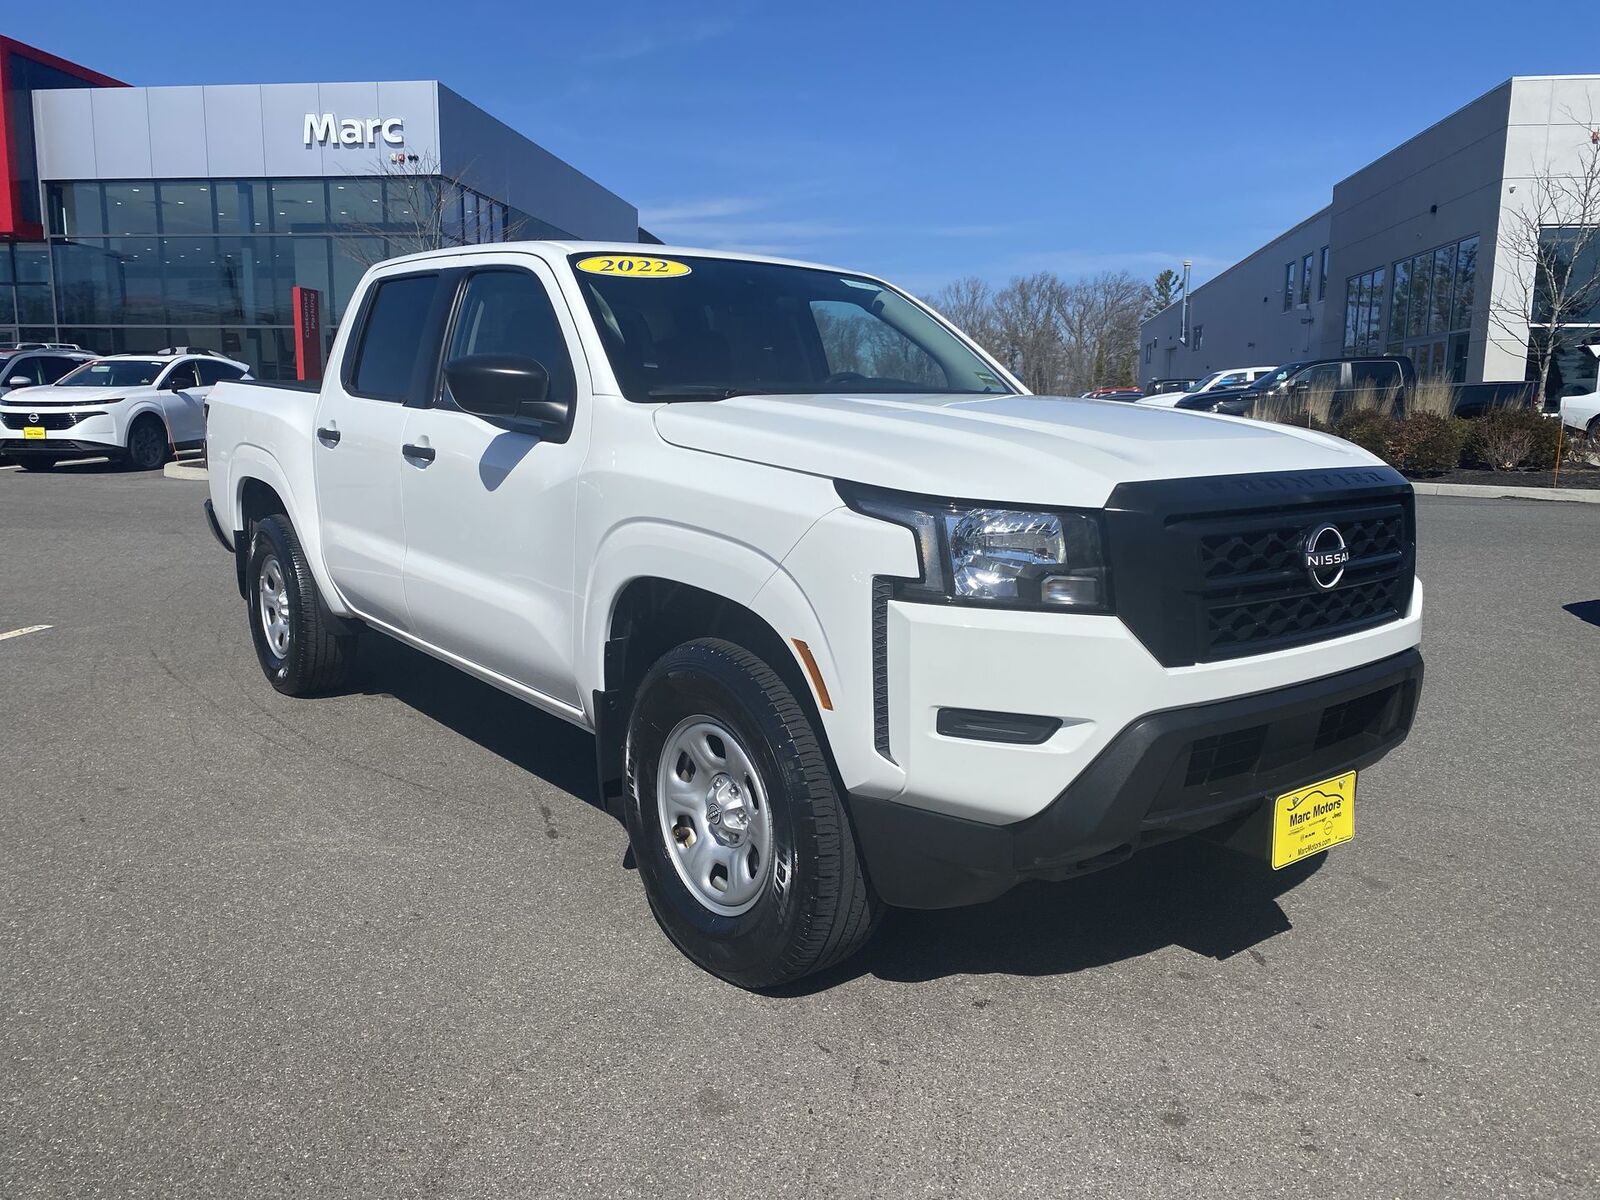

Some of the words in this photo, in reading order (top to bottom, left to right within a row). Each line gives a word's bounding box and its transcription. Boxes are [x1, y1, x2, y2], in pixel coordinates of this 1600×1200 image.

[303, 113, 404, 146] Marc
[600, 260, 670, 273] 2022
[303, 291, 311, 338] Customer
[1290, 811, 1311, 827] Marc
[1313, 799, 1341, 818] Motors
